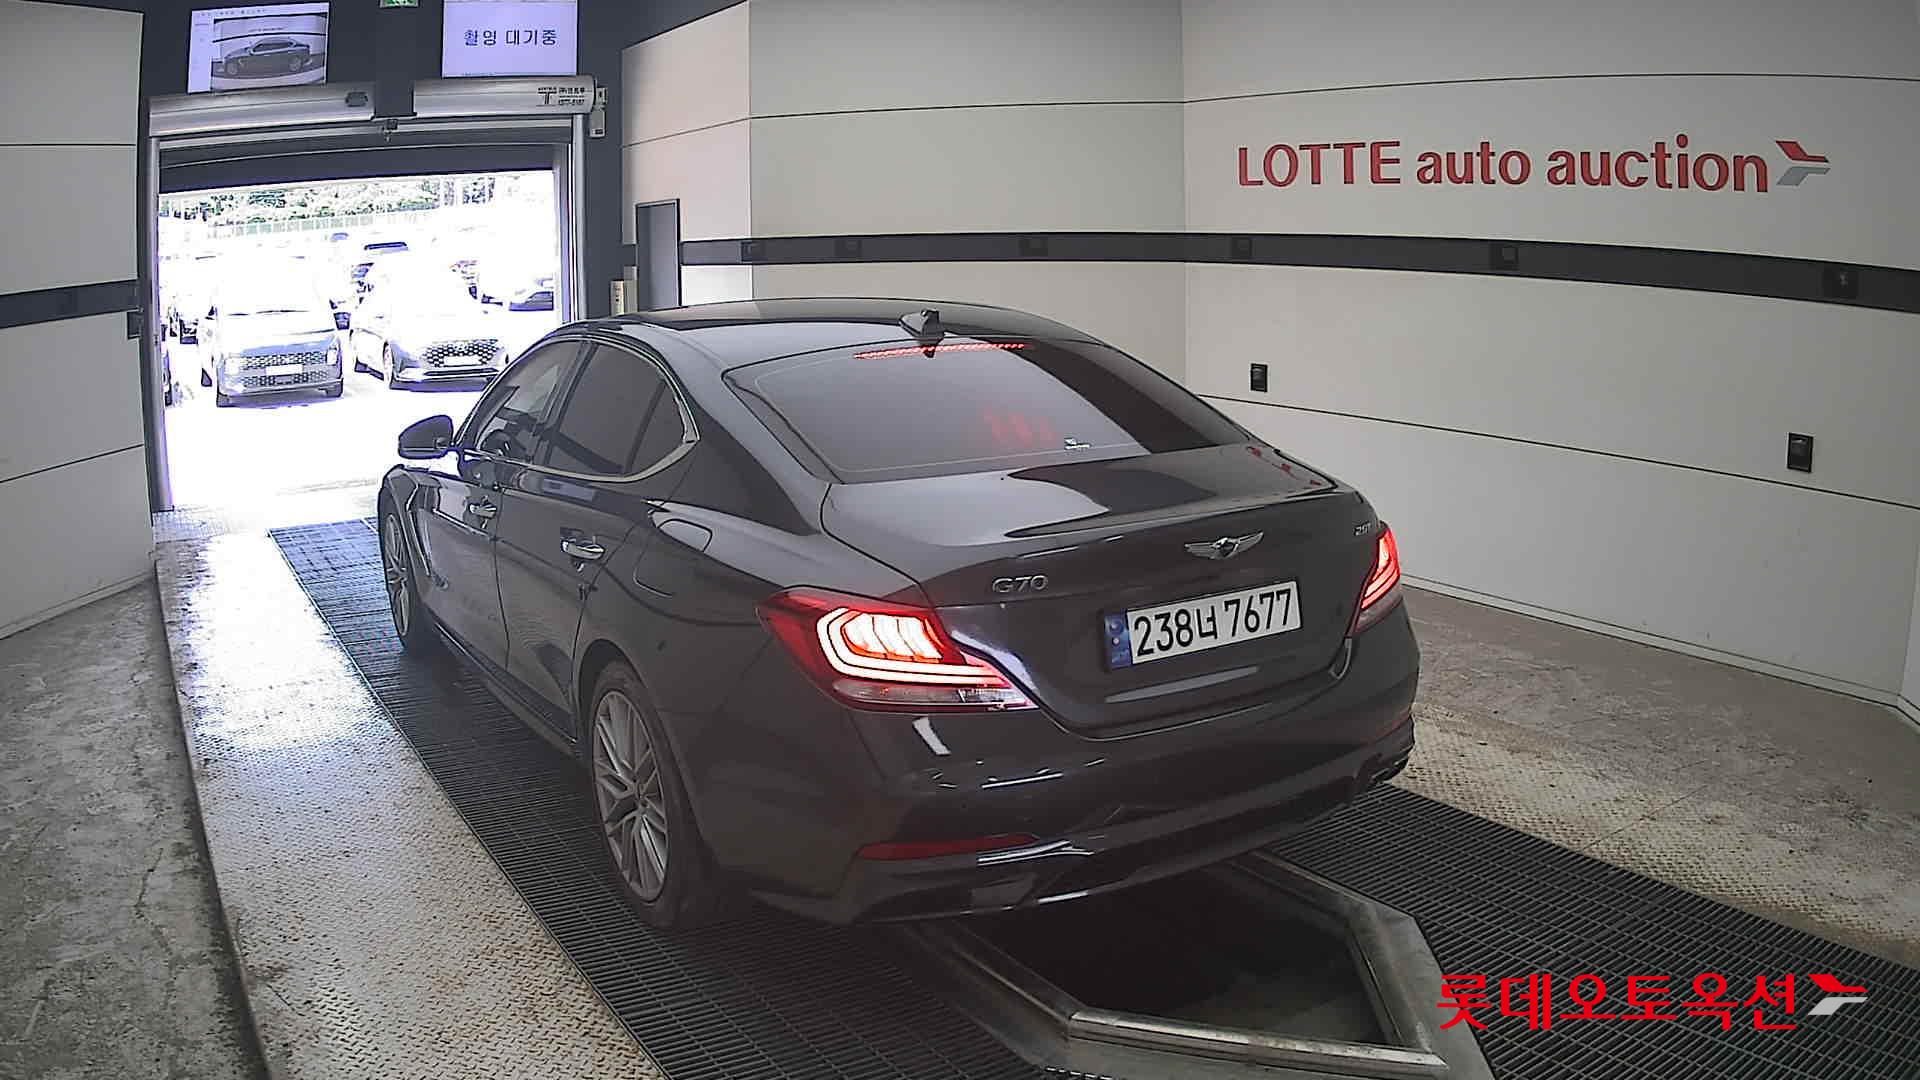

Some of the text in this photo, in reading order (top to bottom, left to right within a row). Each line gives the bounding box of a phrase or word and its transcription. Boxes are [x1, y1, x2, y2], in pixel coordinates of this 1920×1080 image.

[505, 29, 557, 46] 대기중
[1239, 133, 1769, 192] LOTTE auto auction
[992, 574, 1048, 593] G70
[1133, 588, 1292, 657] 238너 7677
